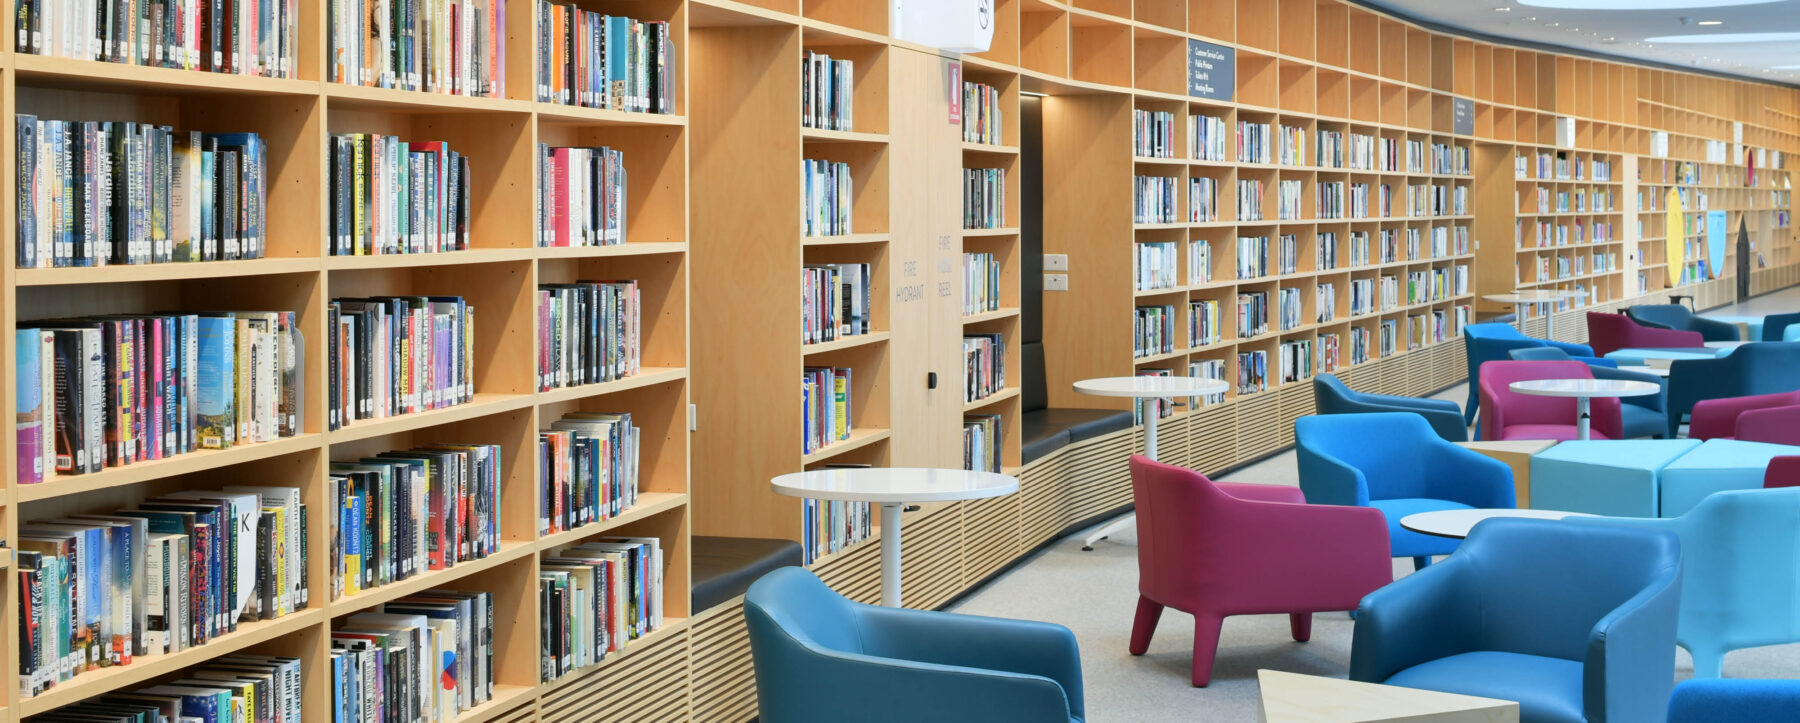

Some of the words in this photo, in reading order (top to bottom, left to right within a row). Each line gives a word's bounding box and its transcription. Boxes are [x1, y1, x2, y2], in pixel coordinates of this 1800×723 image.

[65, 149, 73, 180] JANCE
[84, 182, 92, 200] MAN
[65, 187, 73, 233] DOWNFALL
[84, 202, 92, 243] OVERBOAR
[904, 261, 917, 277] FIRE
[896, 284, 924, 303] HYDRANT
[938, 282, 952, 297] REEL
[241, 512, 250, 533] K
